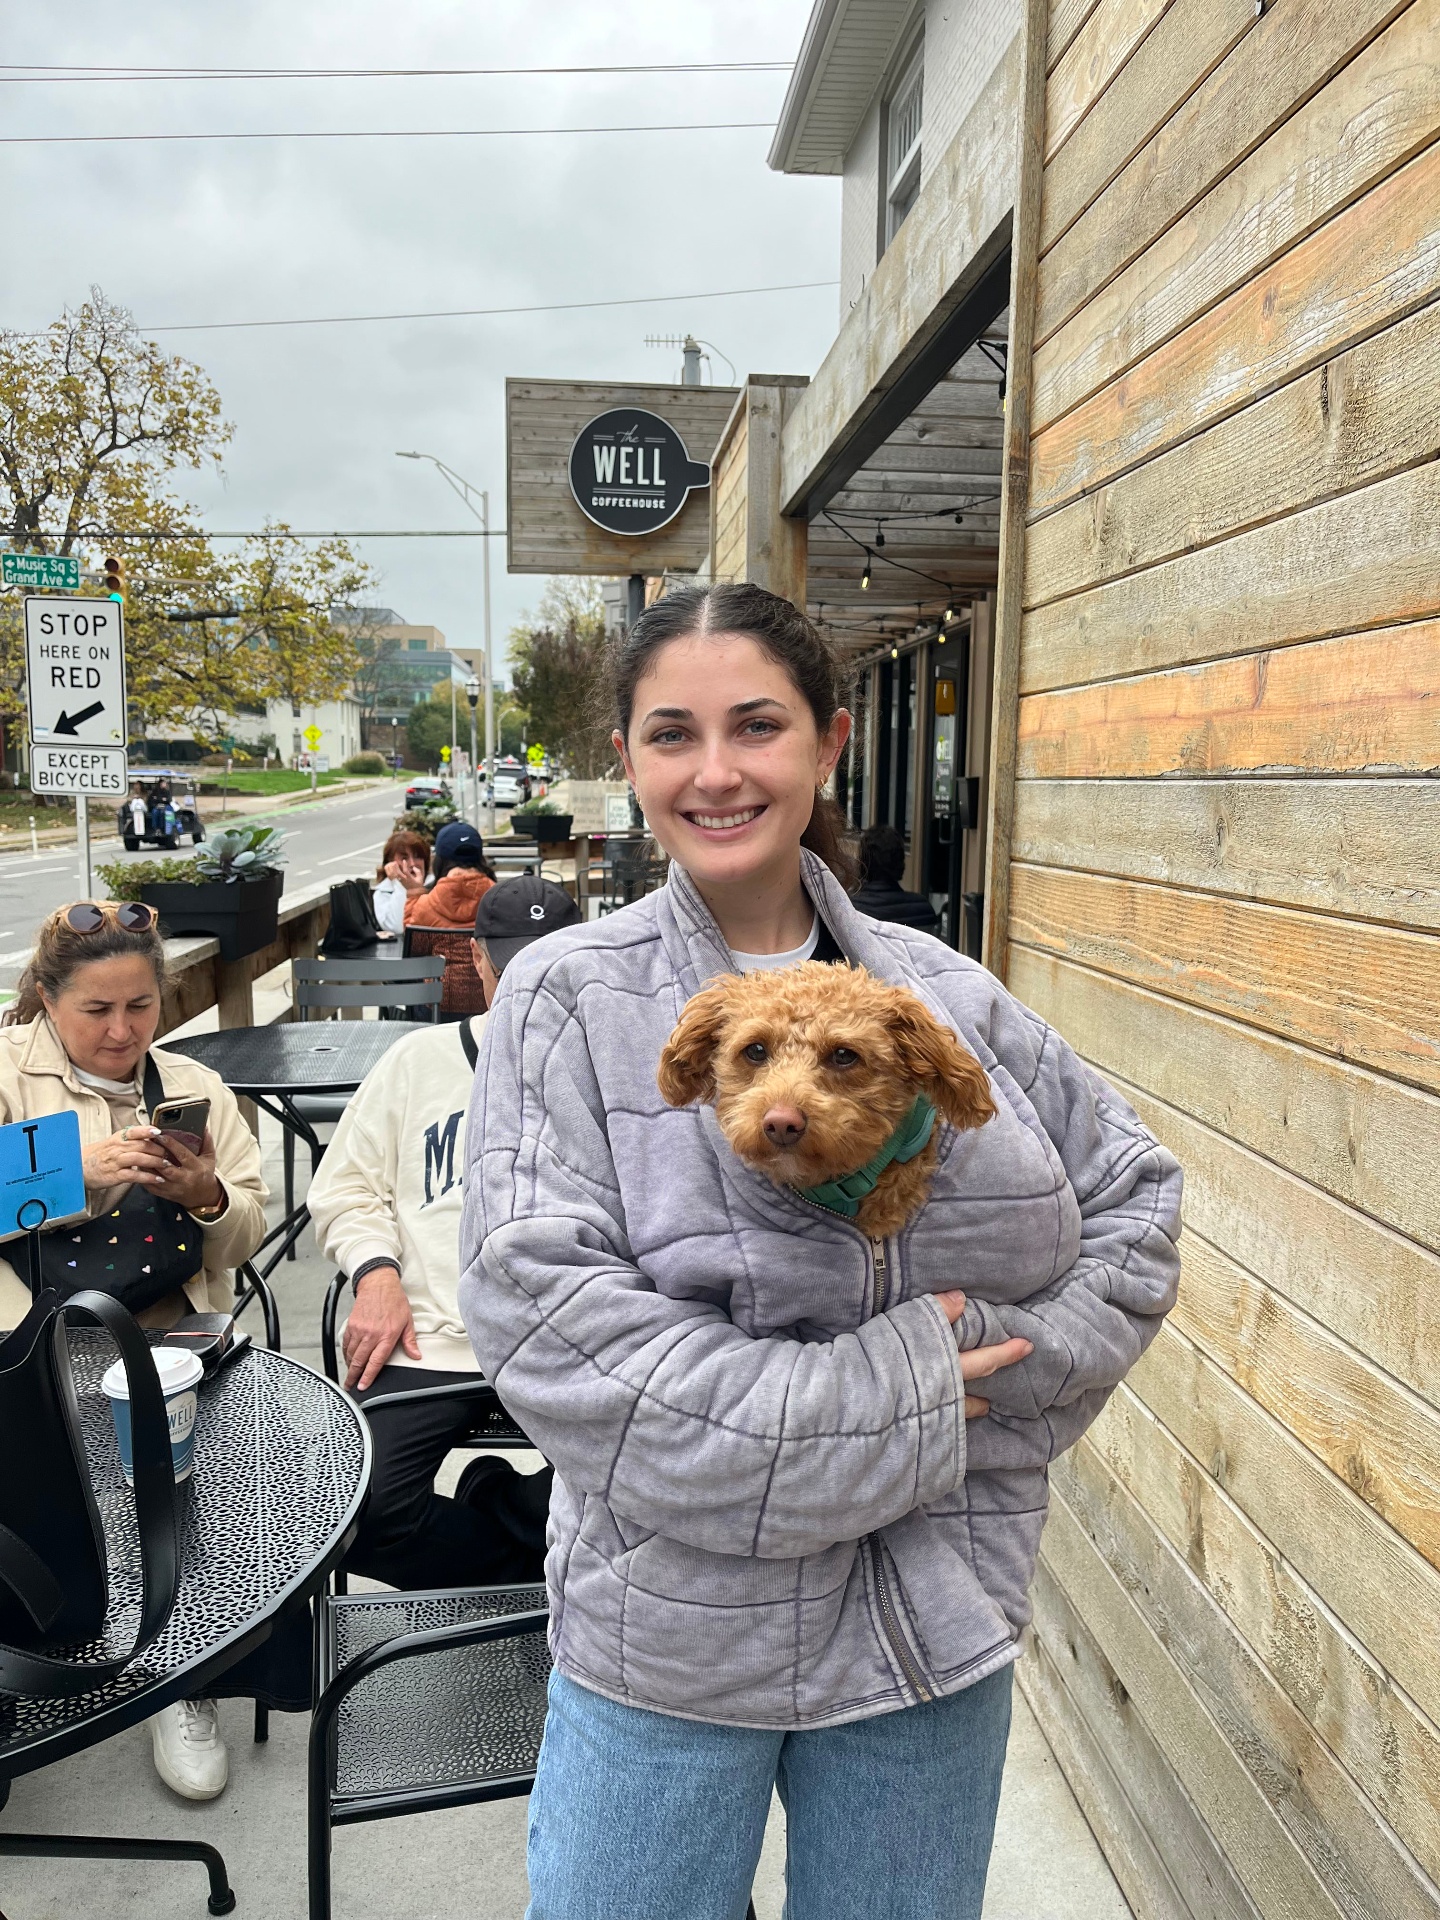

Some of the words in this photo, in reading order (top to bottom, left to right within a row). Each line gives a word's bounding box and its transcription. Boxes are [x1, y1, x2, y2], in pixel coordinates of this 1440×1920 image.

[617, 424, 640, 444] the
[593, 445, 666, 486] WELL
[592, 496, 666, 509] COFFEEHOUSE
[16, 557, 47, 572] Music
[50, 559, 66, 575] Sq
[69, 561, 77, 574] S
[5, 570, 38, 584] Grand
[41, 572, 63, 586] Ave
[40, 613, 108, 637] STOP
[40, 645, 80, 660] HERE
[88, 646, 110, 660] ON
[51, 666, 101, 689] RED
[48, 753, 109, 770] EXCEPT
[39, 772, 120, 789] BICYCLES
[22, 1124, 39, 1174] T
[418, 1109, 465, 1212] M
